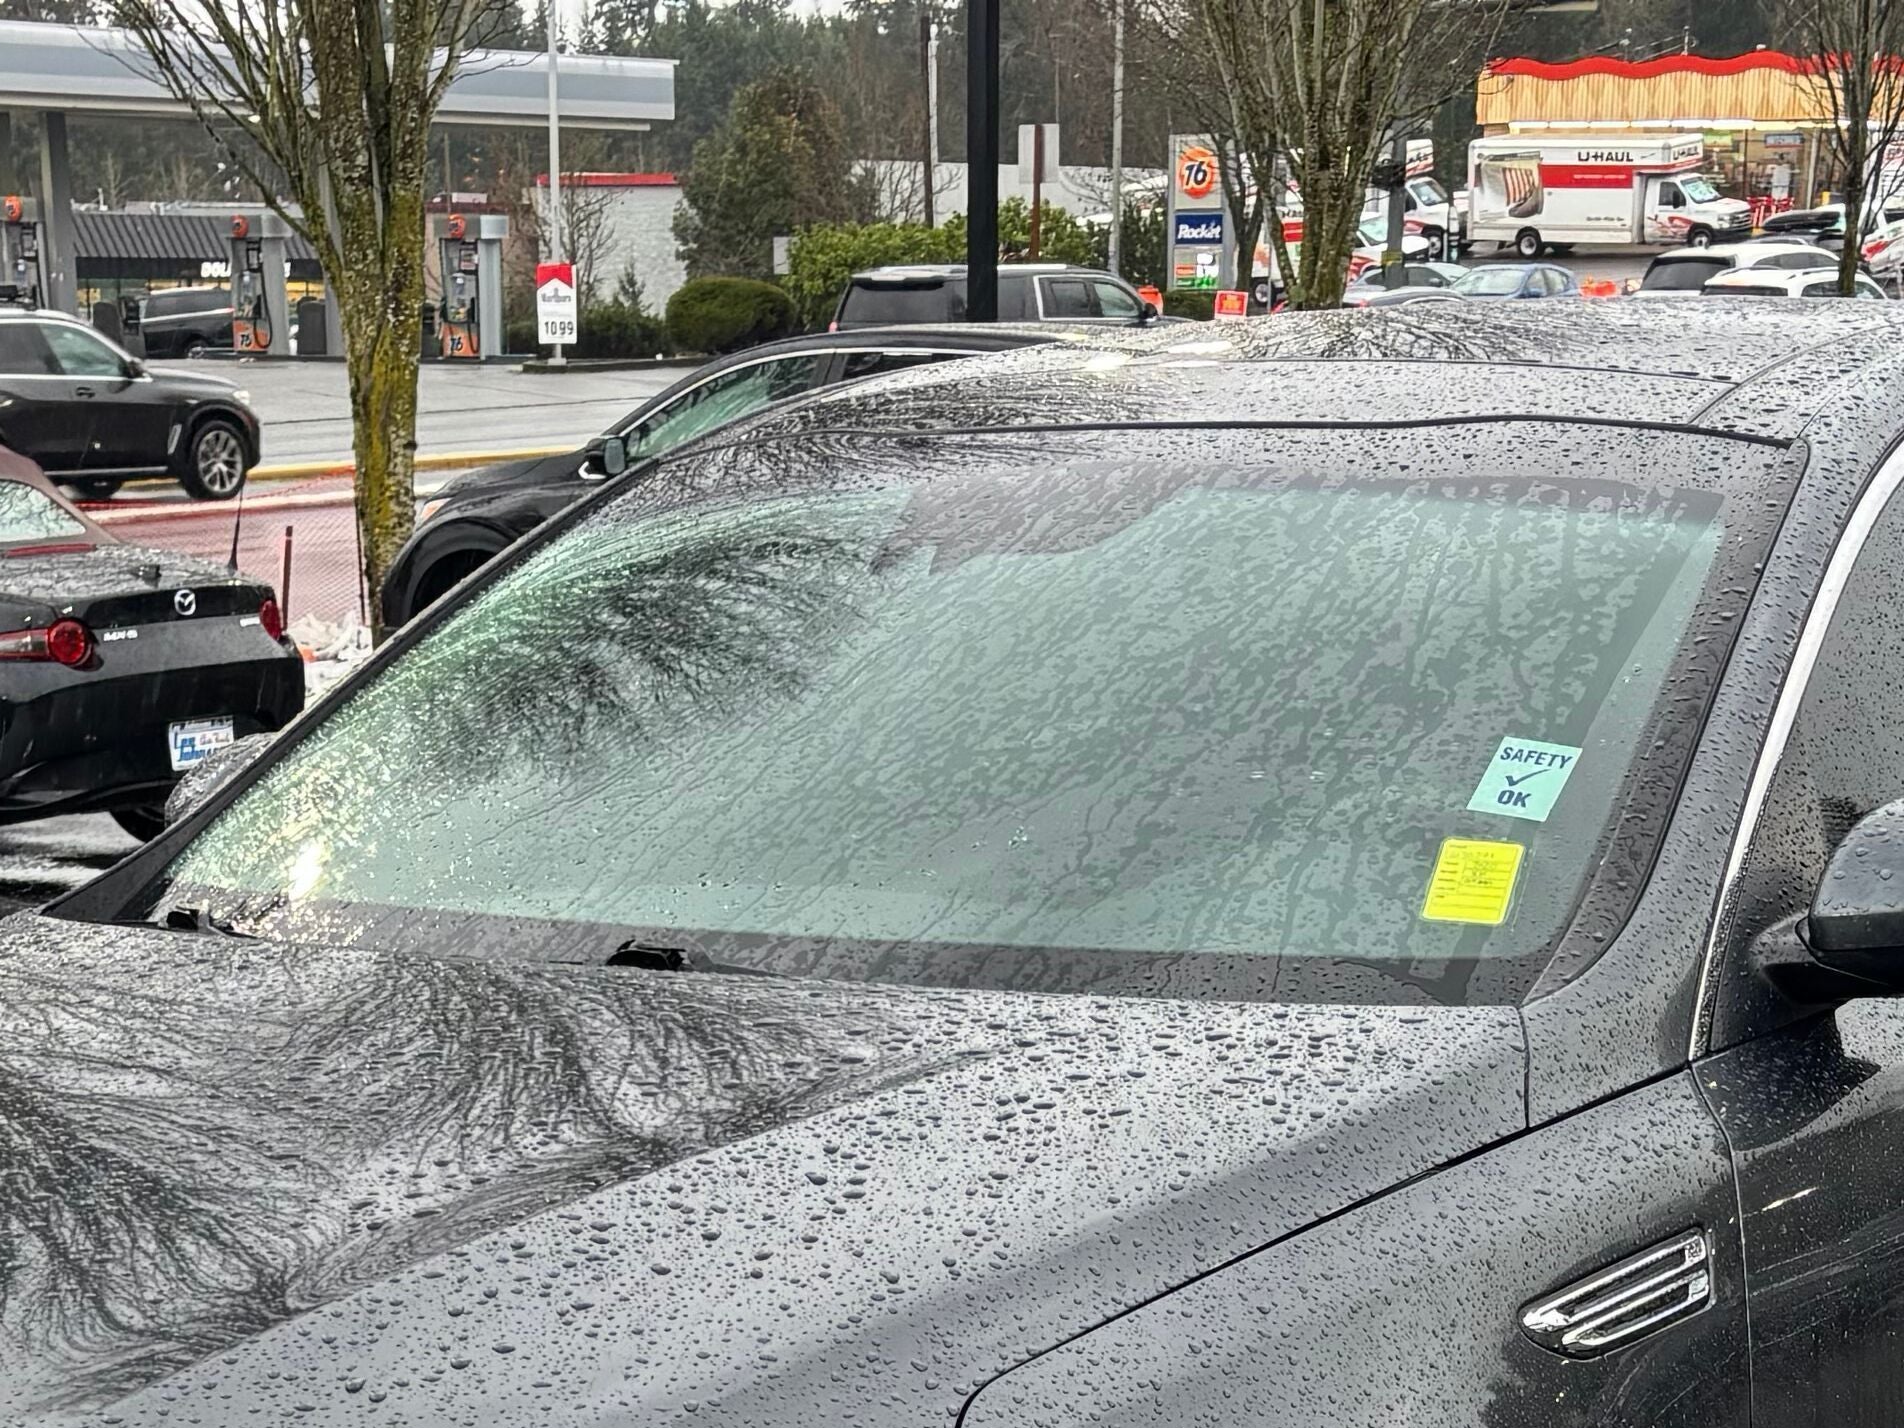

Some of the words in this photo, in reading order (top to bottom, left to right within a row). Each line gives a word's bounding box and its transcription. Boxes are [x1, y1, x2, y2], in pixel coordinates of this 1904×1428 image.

[1578, 151, 1633, 162] U-HAUL
[1183, 160, 1209, 187] 76
[1499, 746, 1574, 769] SAFETY
[1497, 789, 1532, 809] OK
